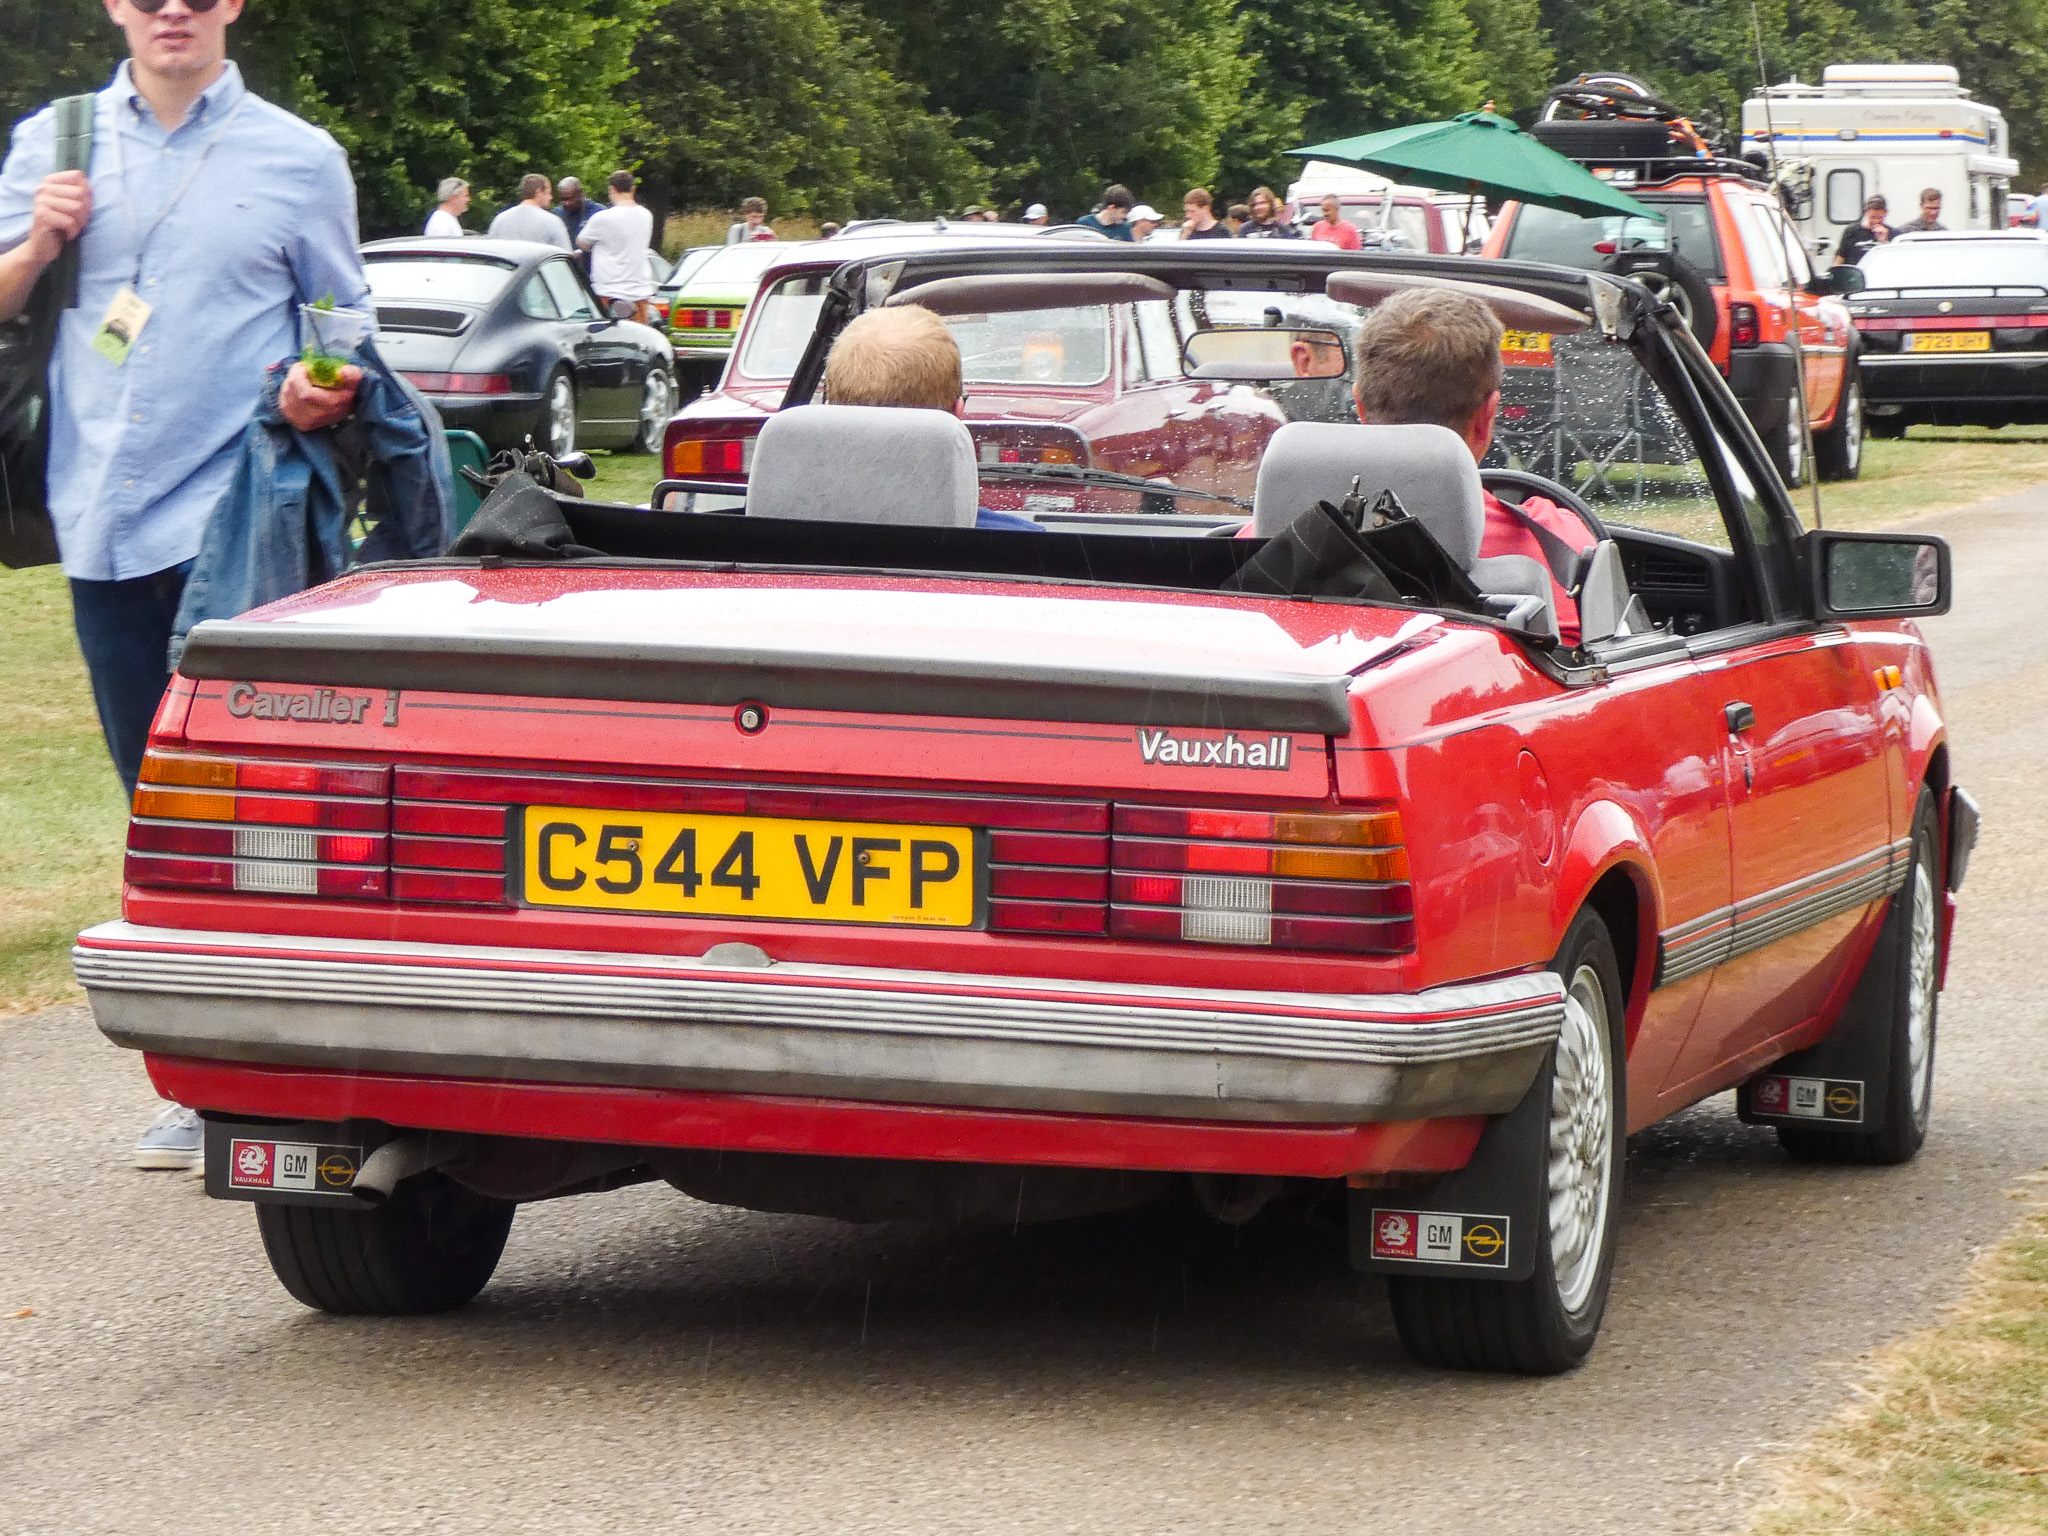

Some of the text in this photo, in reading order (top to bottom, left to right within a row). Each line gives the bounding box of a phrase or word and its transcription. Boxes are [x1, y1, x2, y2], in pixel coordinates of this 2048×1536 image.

[226, 682, 371, 724] Cavalier
[1138, 729, 1290, 769] Vauxhall
[537, 821, 960, 909] C544 VFP
[283, 1154, 308, 1173] GM
[234, 1176, 271, 1185] VAUXHALL
[1427, 1224, 1452, 1243] GM
[1376, 1247, 1415, 1256] VAUXHALL
